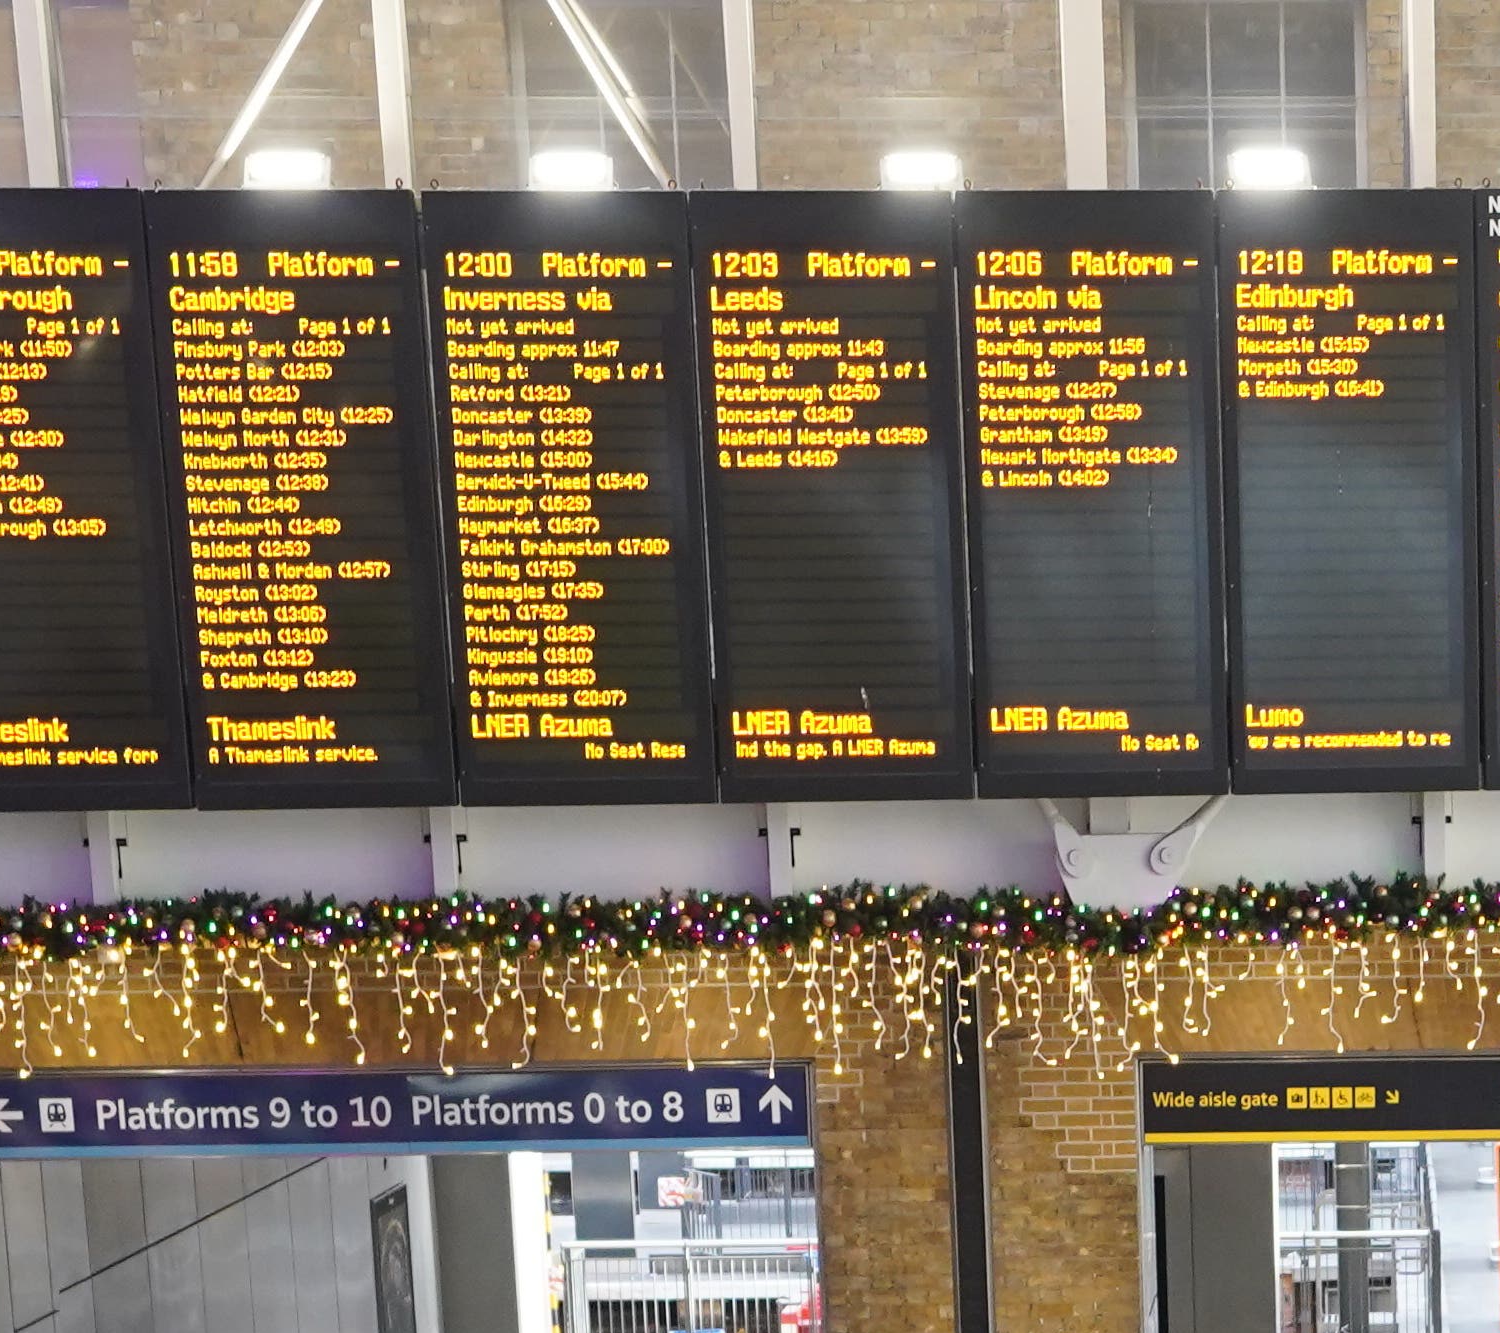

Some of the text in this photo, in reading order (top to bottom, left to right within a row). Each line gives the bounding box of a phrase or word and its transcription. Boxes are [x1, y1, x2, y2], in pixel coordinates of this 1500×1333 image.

[171, 251, 239, 277] 11:58
[447, 252, 647, 277] 12:00 Platform
[714, 252, 779, 278] 12:03
[978, 250, 1043, 276] 12:06
[1240, 249, 1433, 275] 12:18 Platform
[171, 286, 296, 314] Cambridge
[445, 286, 613, 311] Inverness via
[712, 286, 784, 311] Leeds
[976, 284, 1103, 310] Lincoln via
[1237, 282, 1355, 311] Edinburgh
[473, 713, 614, 738] LNER Azuma
[1247, 706, 1305, 728] Lumo
[96, 1096, 391, 1130] Platforms 9 to 10
[412, 1085, 684, 1125] Platforms 0 to 8
[1153, 1092, 1278, 1110] Wide aisle gate
